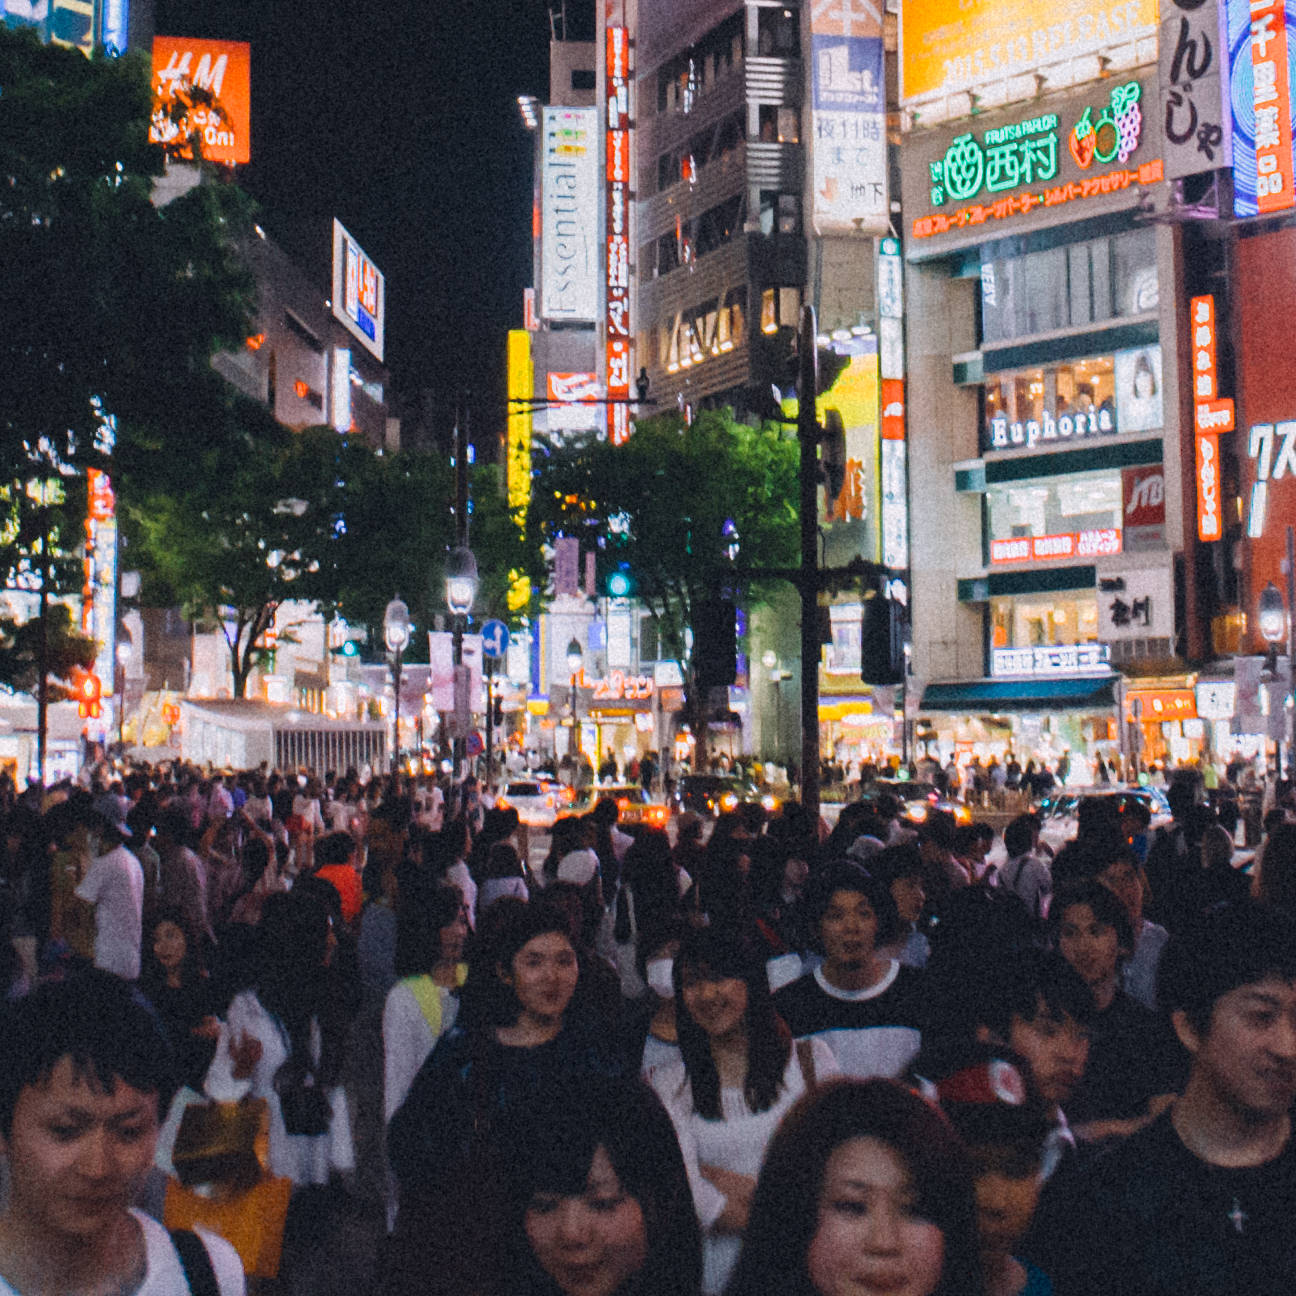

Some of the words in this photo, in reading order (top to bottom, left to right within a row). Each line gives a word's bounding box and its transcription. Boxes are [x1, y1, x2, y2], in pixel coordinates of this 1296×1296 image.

[1031, 0, 1142, 54] RELEASE
[985, 132, 1058, 193] 西村
[548, 161, 578, 313] Essential
[991, 405, 1113, 448] Euphoria
